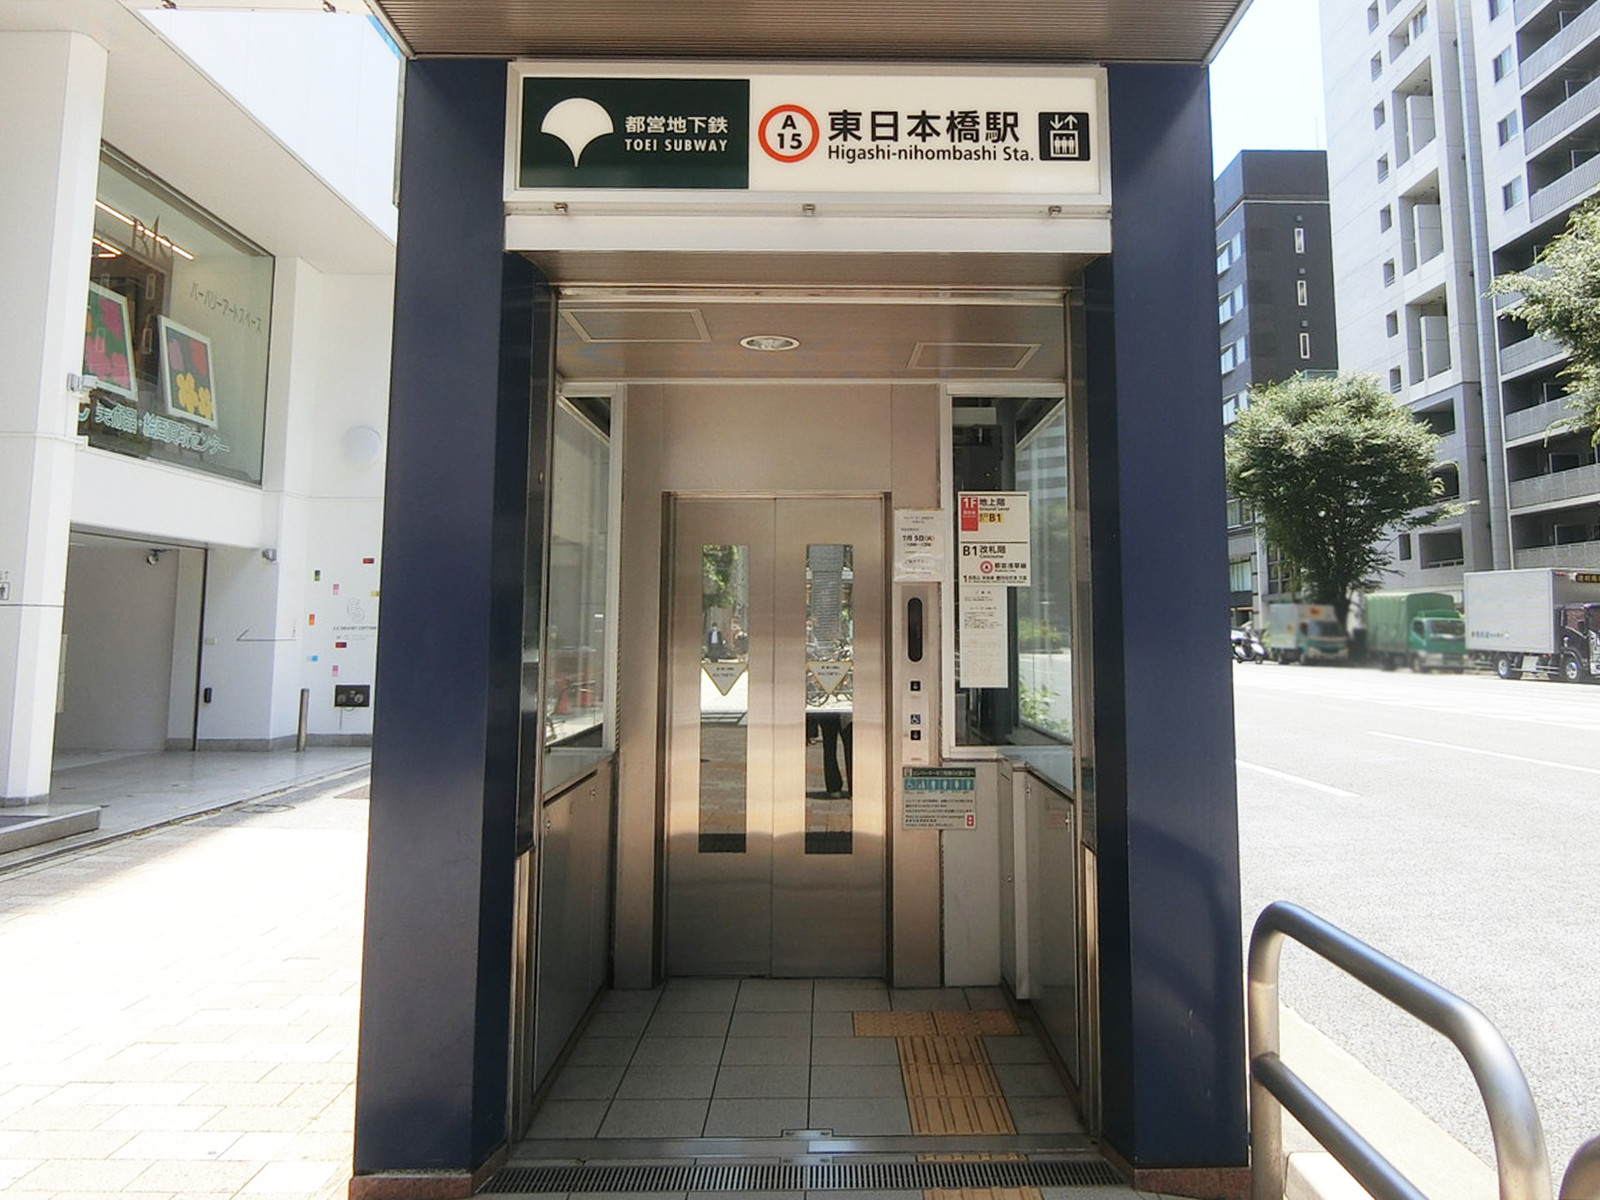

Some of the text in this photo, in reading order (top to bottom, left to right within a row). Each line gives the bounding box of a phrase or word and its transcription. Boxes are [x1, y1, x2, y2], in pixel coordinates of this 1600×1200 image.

[625, 116, 729, 134] 都営地下鉄
[782, 115, 797, 130] A
[828, 110, 1020, 143] 東日本橋駅
[625, 139, 728, 152] TOEI SUBWAY
[777, 133, 803, 150] 15
[828, 145, 1034, 164] Higashi-nihombashi Sta.
[963, 498, 977, 508] 1F
[989, 513, 1001, 522] B1
[963, 545, 977, 556] B1
